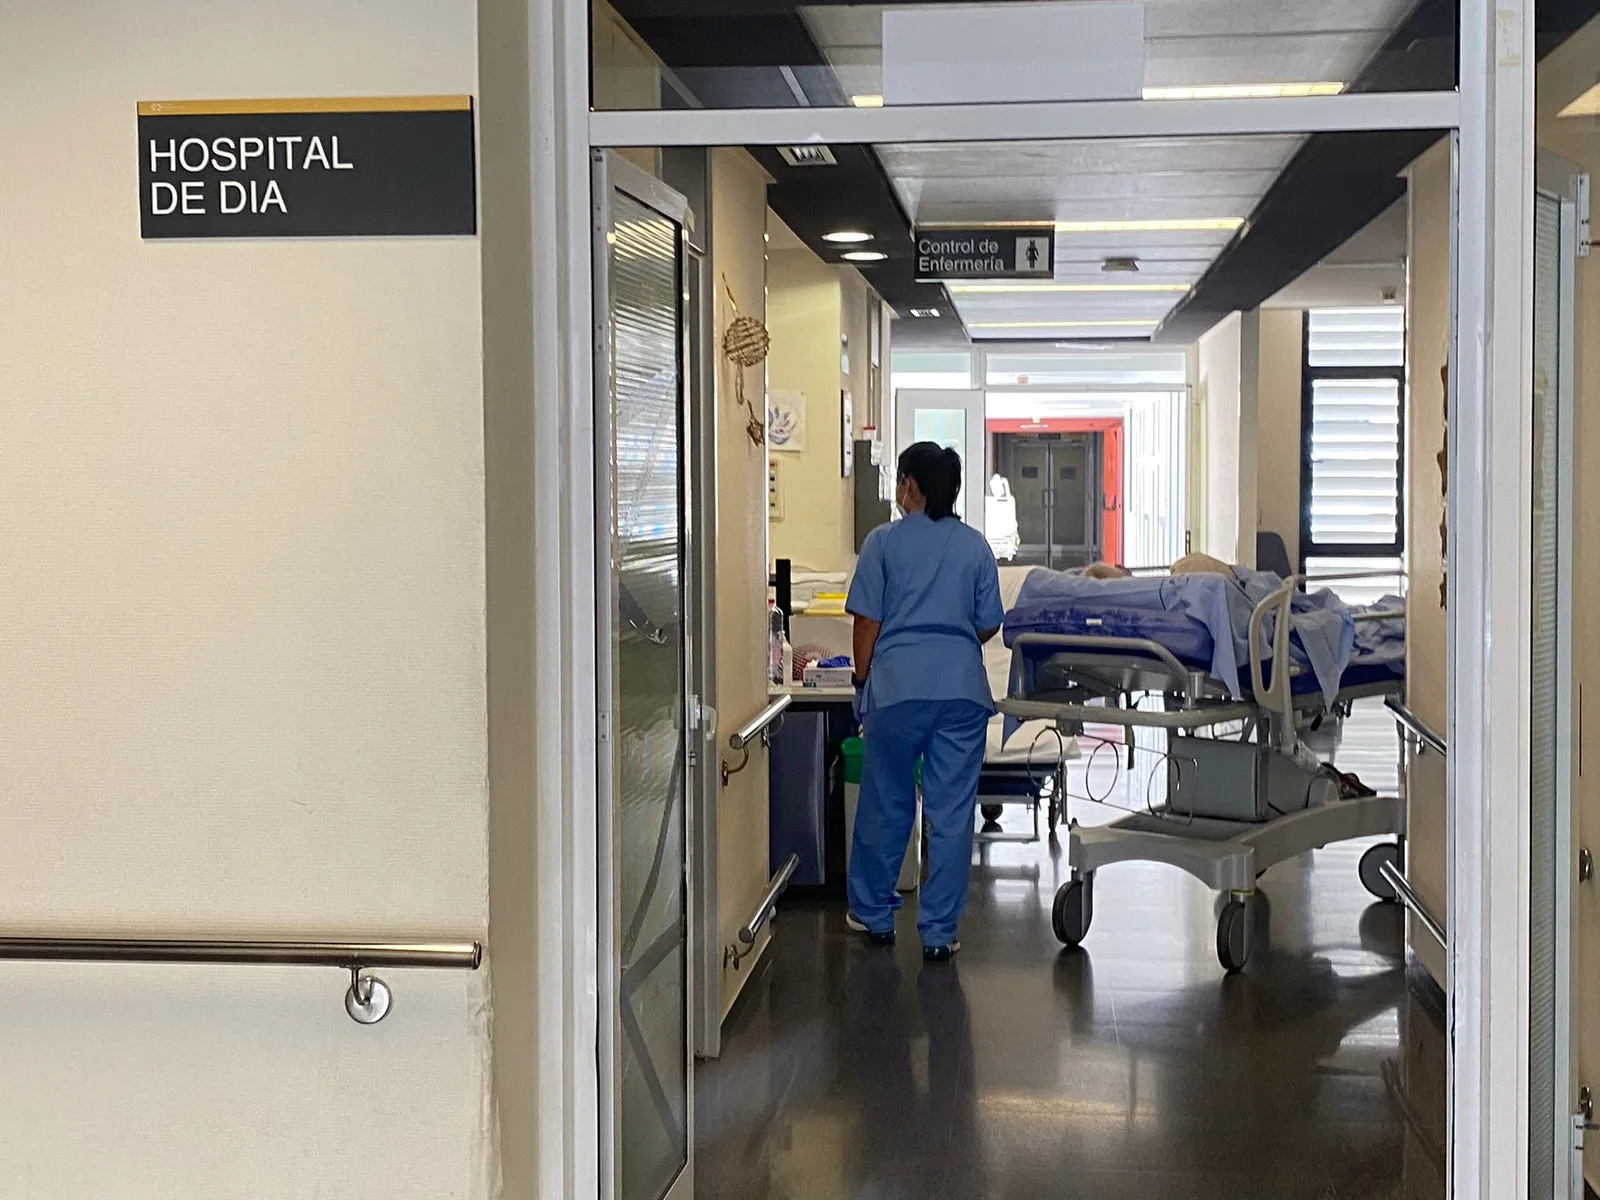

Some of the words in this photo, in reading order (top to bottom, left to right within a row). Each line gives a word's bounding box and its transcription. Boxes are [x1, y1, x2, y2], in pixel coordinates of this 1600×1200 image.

[150, 135, 354, 173] HOSPITAL
[151, 181, 206, 215] DE
[219, 179, 288, 215] DIA
[918, 238, 974, 255] Control
[979, 238, 999, 254] de
[918, 255, 1005, 272] Enfermería
